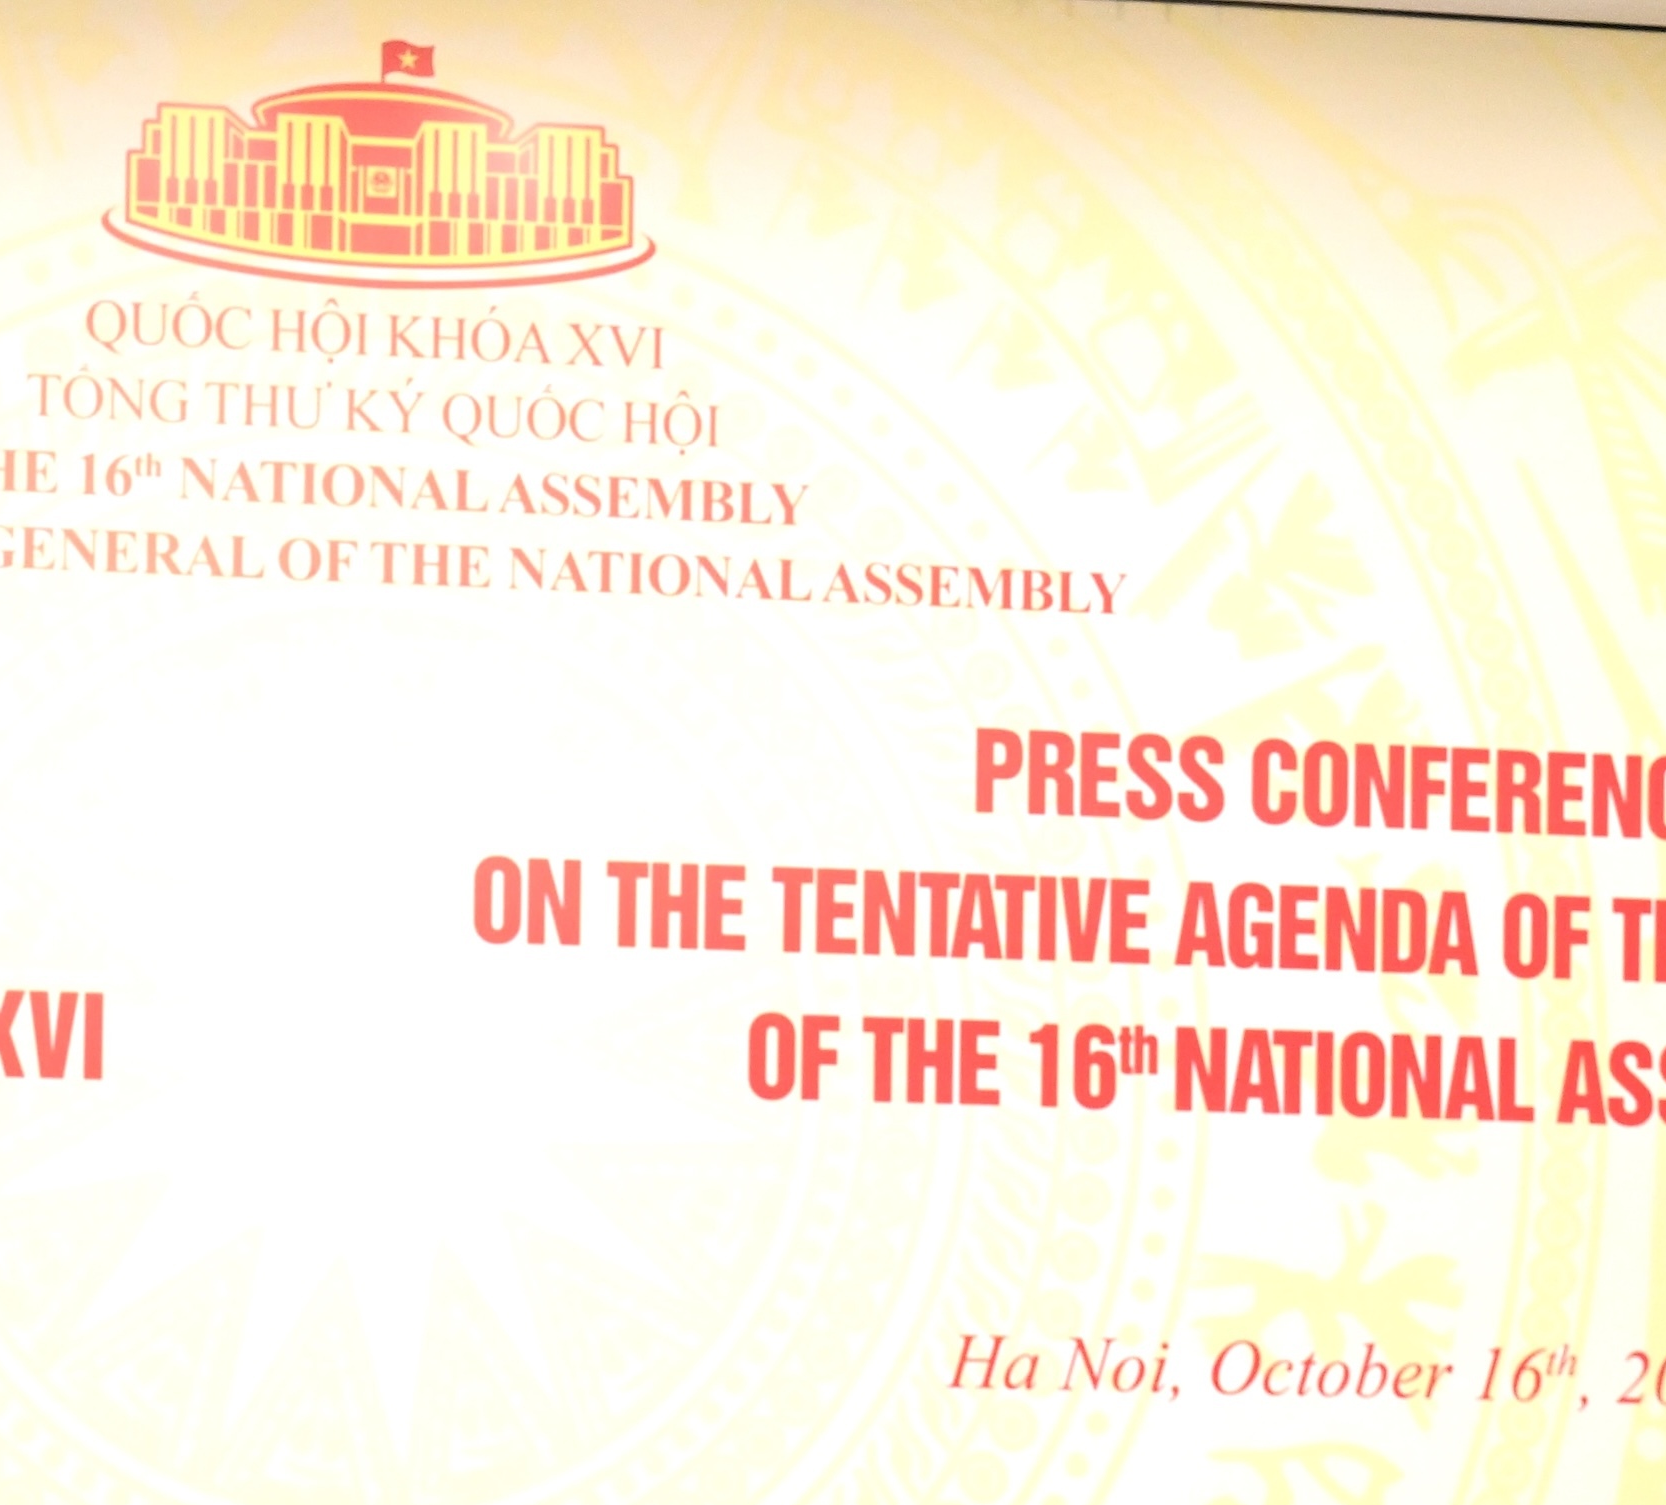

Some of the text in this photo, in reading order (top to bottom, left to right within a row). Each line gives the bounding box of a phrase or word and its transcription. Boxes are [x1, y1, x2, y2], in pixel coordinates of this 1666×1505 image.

[86, 291, 664, 370] QUỐC HỘI KHÓA XVI
[27, 363, 719, 455] TỔNG THƯ KÝ QUỐC HỘI
[182, 457, 489, 513] NATIONAL
[501, 474, 808, 527] ASSEMBLY
[278, 539, 358, 584] OF
[371, 541, 491, 589] THE
[511, 548, 812, 602] NATIONAL
[823, 564, 1127, 616] ASSEMBLY
[976, 728, 1224, 822] PRESS
[474, 856, 581, 945] ON
[607, 861, 746, 951] THE
[772, 868, 1150, 964] TENTATIVE
[1175, 882, 1478, 976] AGENDA
[1503, 893, 1591, 979] OF
[749, 1012, 840, 1100] OF
[863, 1017, 1000, 1105] THE
[1175, 1027, 1534, 1122] NATIONAL
[950, 1335, 1039, 1390] Ha
[1063, 1337, 1179, 1398] Noi,
[1211, 1341, 1453, 1399] October
